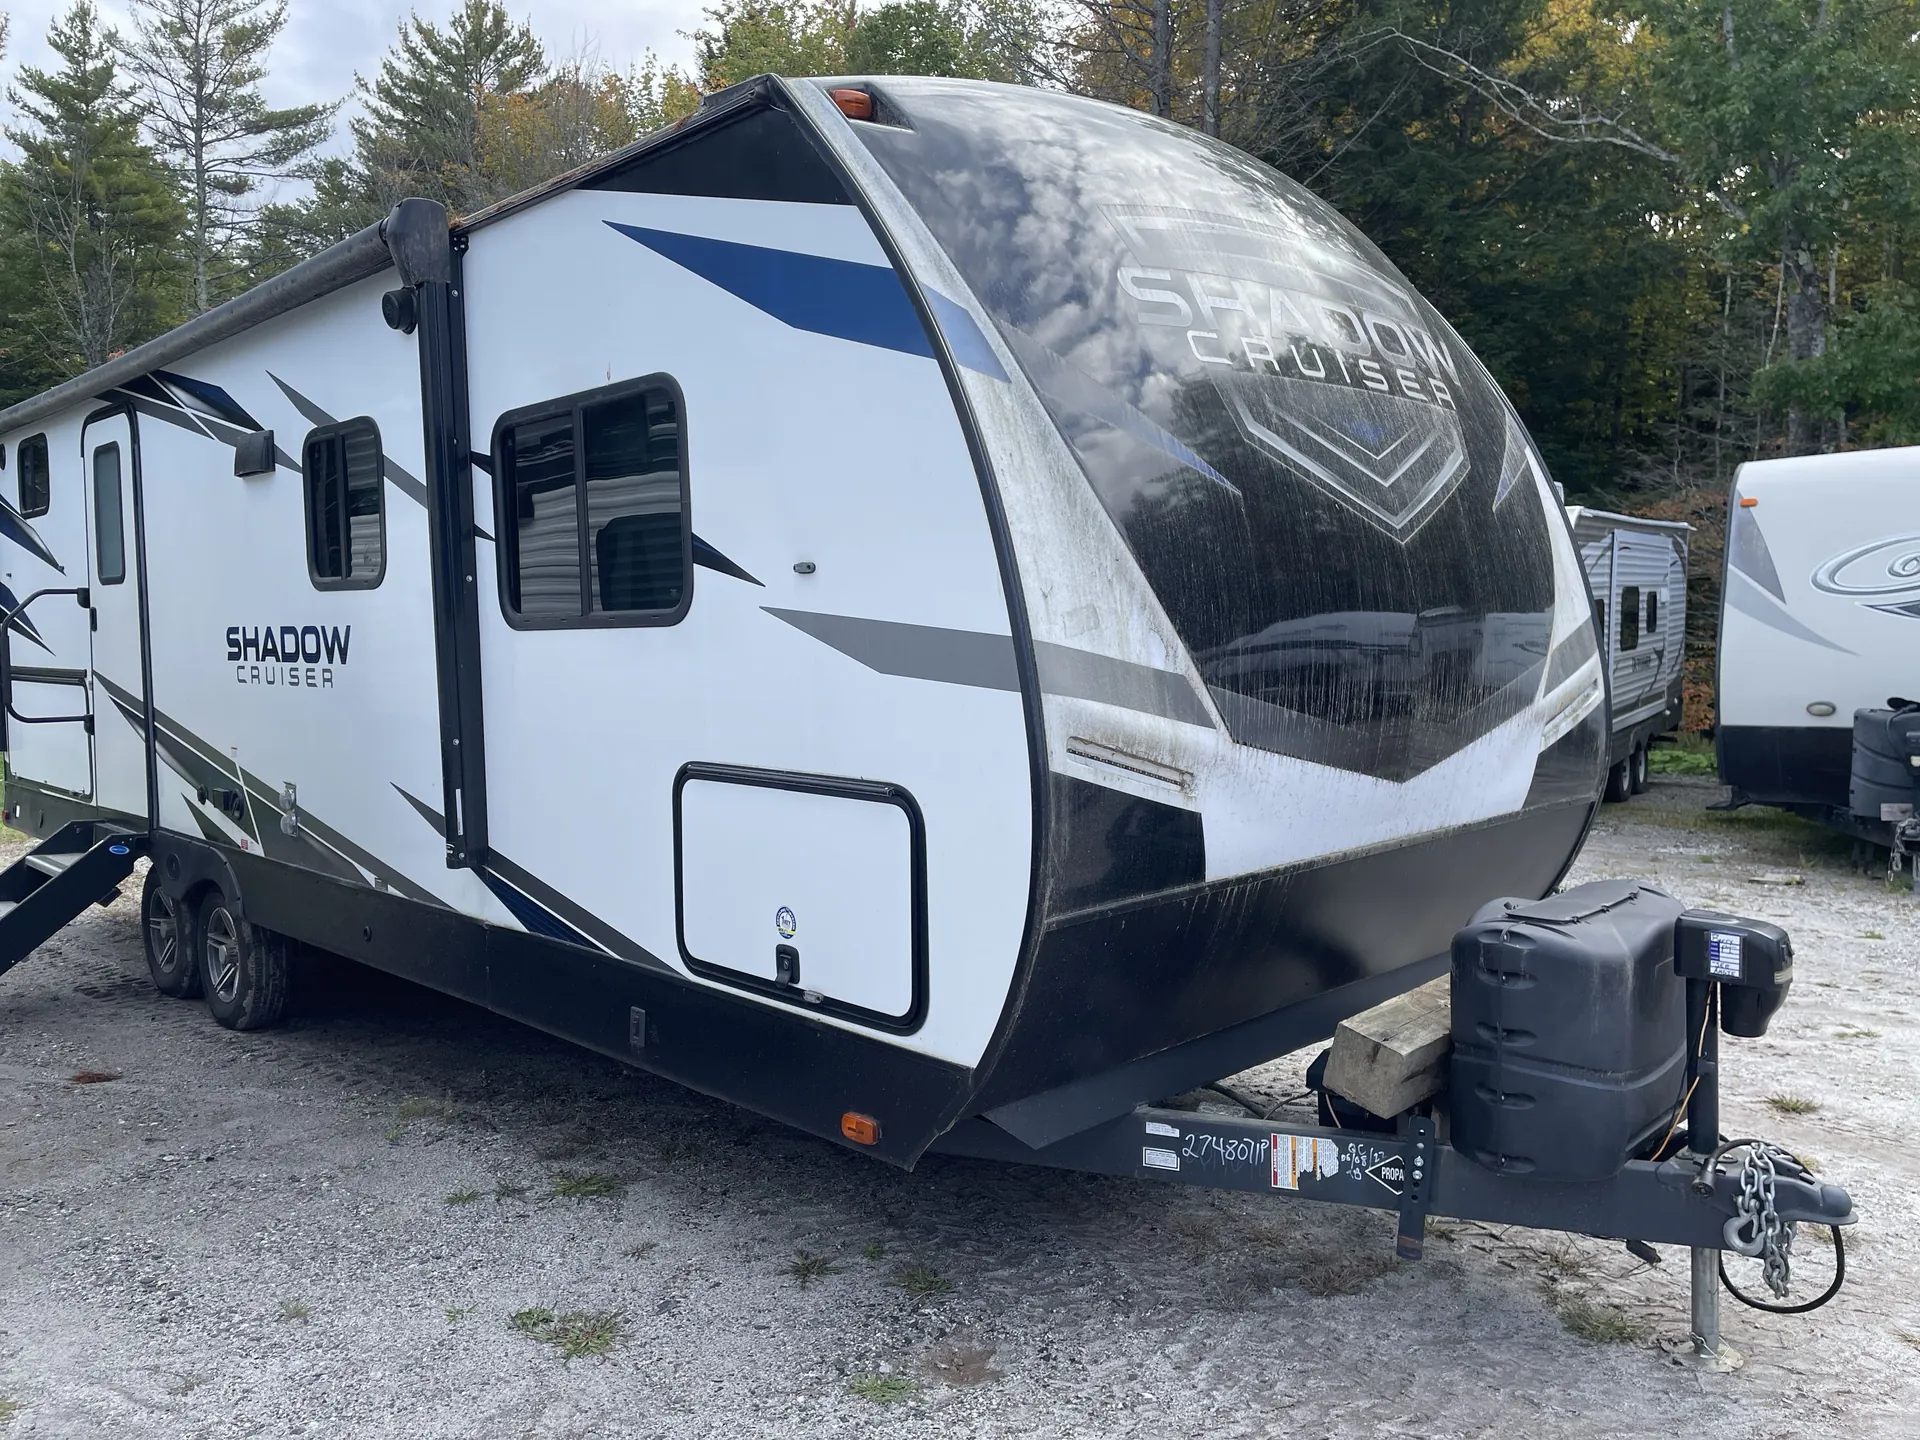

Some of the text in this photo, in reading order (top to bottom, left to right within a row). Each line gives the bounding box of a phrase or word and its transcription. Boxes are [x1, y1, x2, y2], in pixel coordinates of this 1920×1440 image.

[1117, 266, 1461, 387] SHADOW
[1186, 329, 1457, 410] CRUISER
[226, 625, 351, 664] SHADOW
[236, 665, 334, 688] CRUISER
[1381, 1166, 1405, 1182] PROPA
